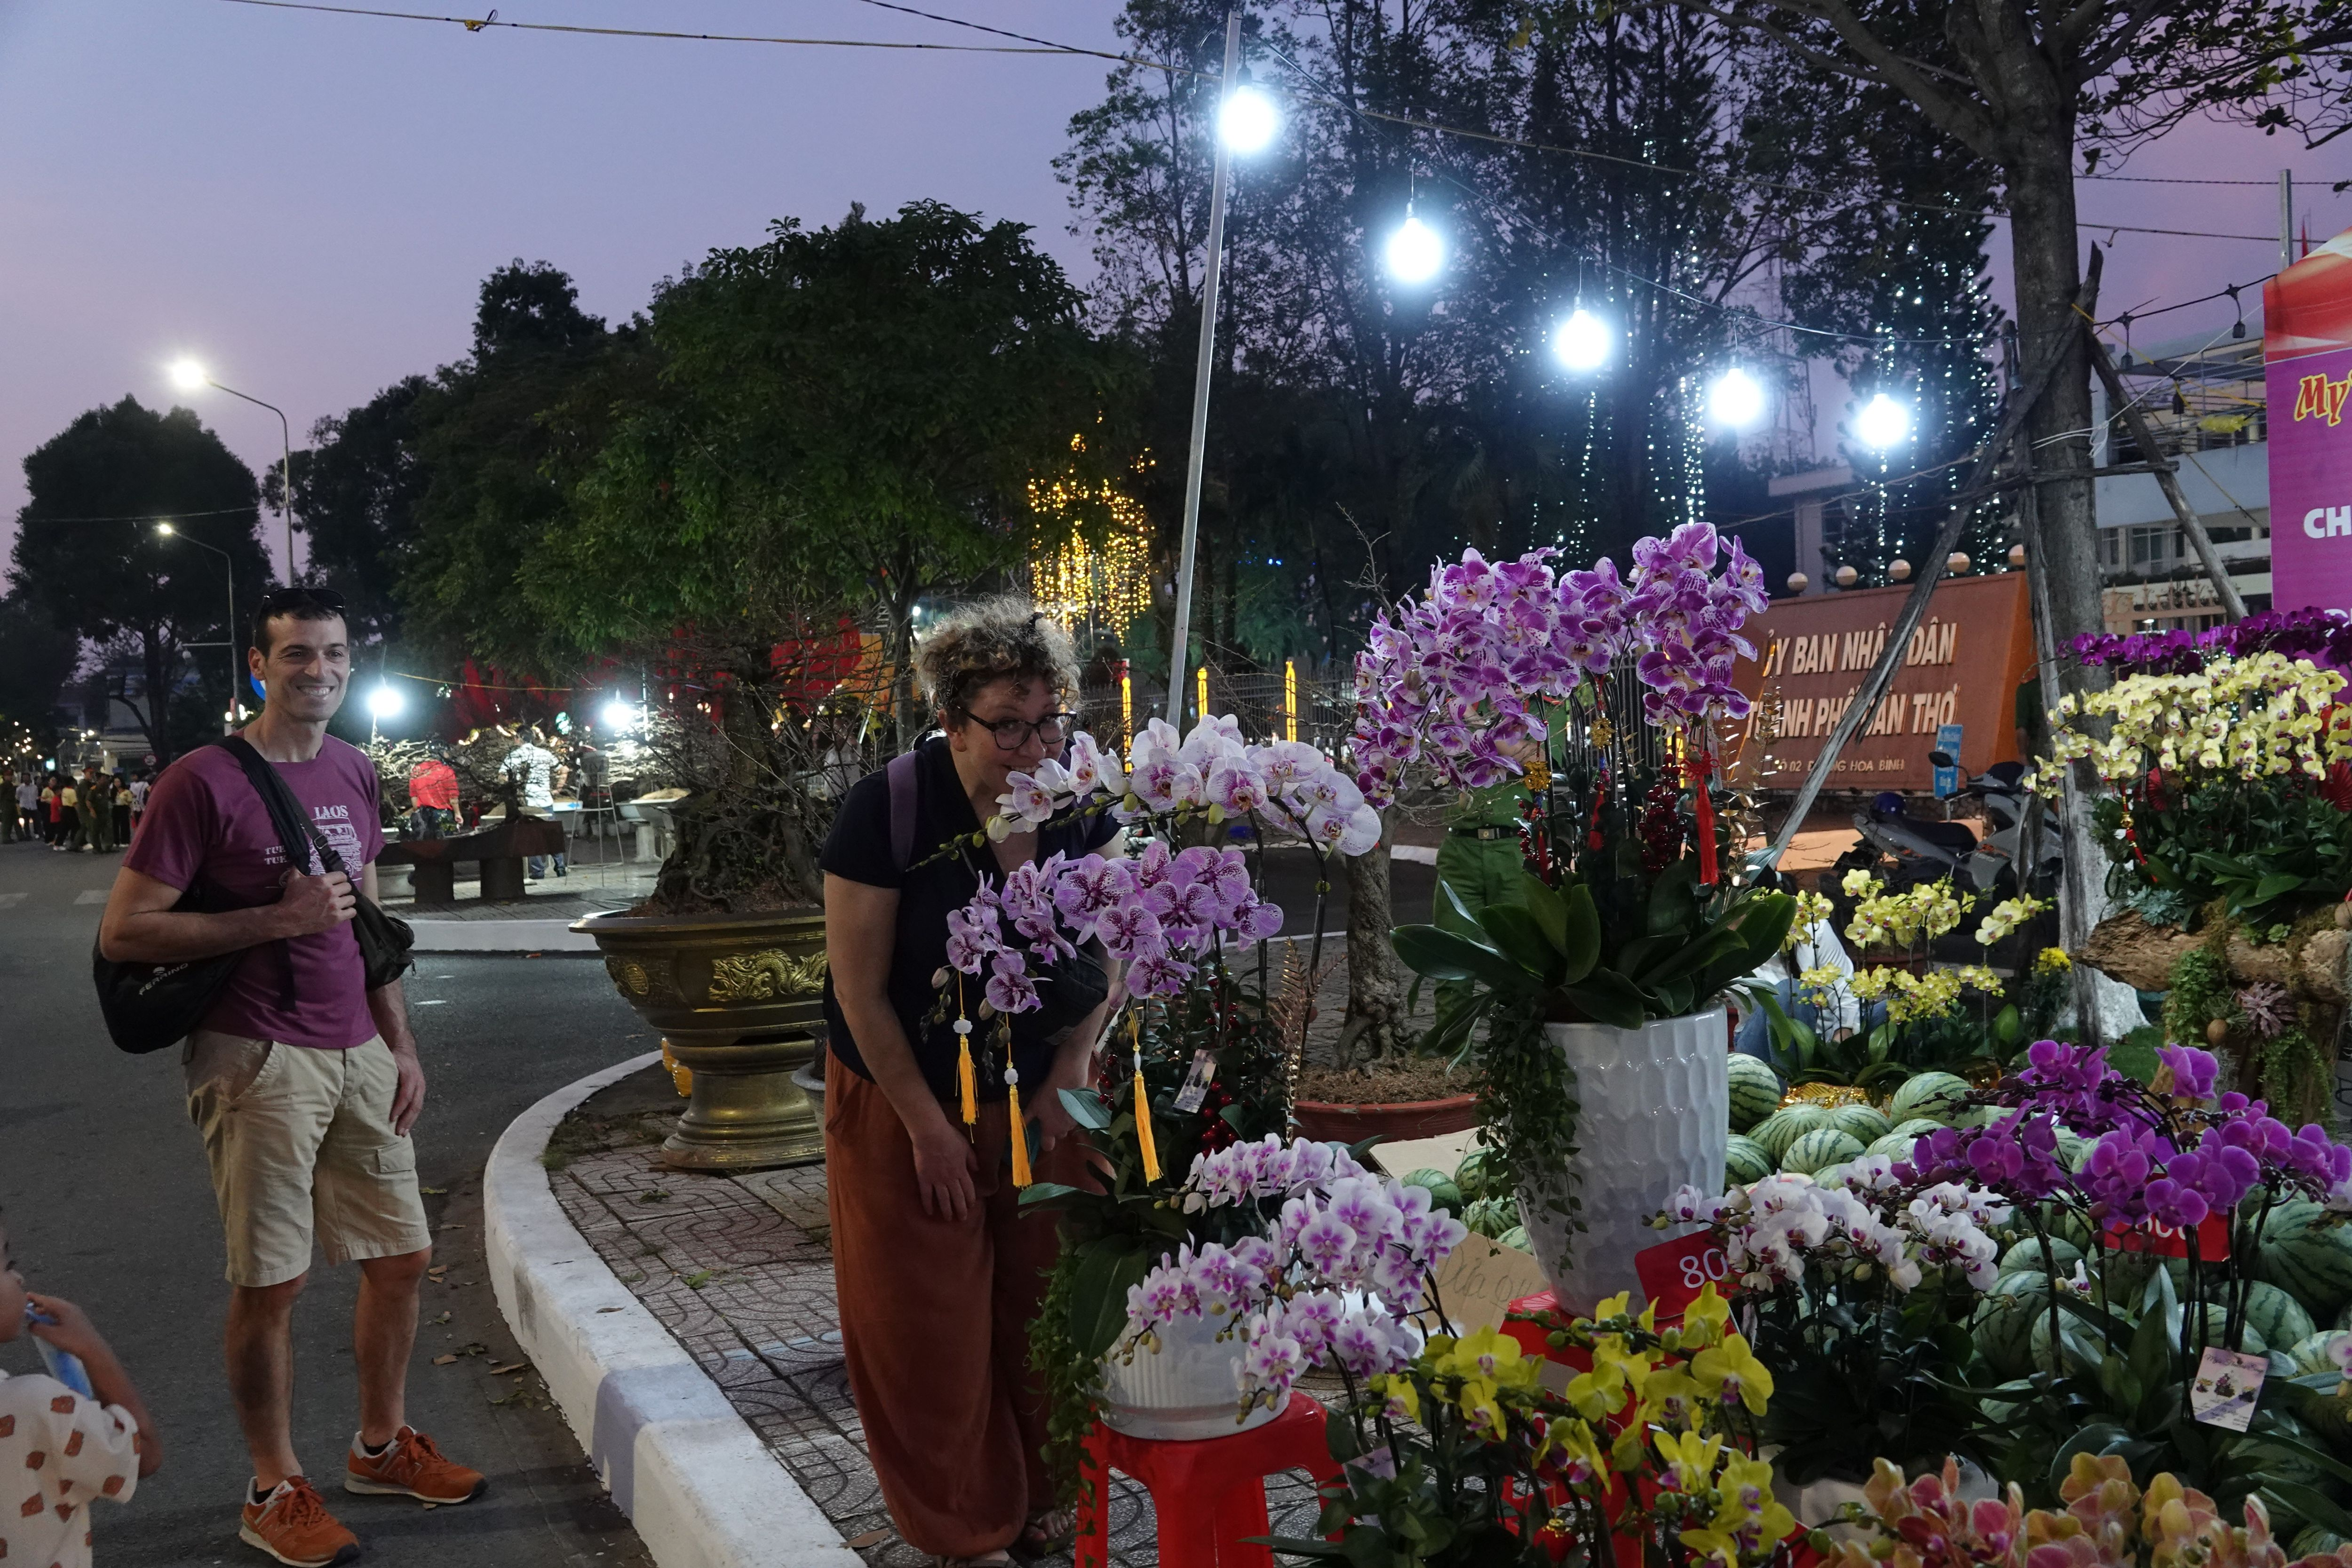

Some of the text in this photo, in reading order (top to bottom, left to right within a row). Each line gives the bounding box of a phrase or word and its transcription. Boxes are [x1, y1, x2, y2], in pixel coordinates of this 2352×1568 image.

[2295, 369, 2352, 427] My
[2304, 505, 2352, 539] CH
[1791, 634, 1838, 674] BAN
[1841, 621, 1895, 671] NHÂ
[1907, 616, 1957, 666] DÂN
[1913, 683, 1958, 734] THƠ
[1789, 760, 1802, 772] 02
[314, 805, 349, 819] LAOS
[1679, 1248, 1747, 1288] 80
